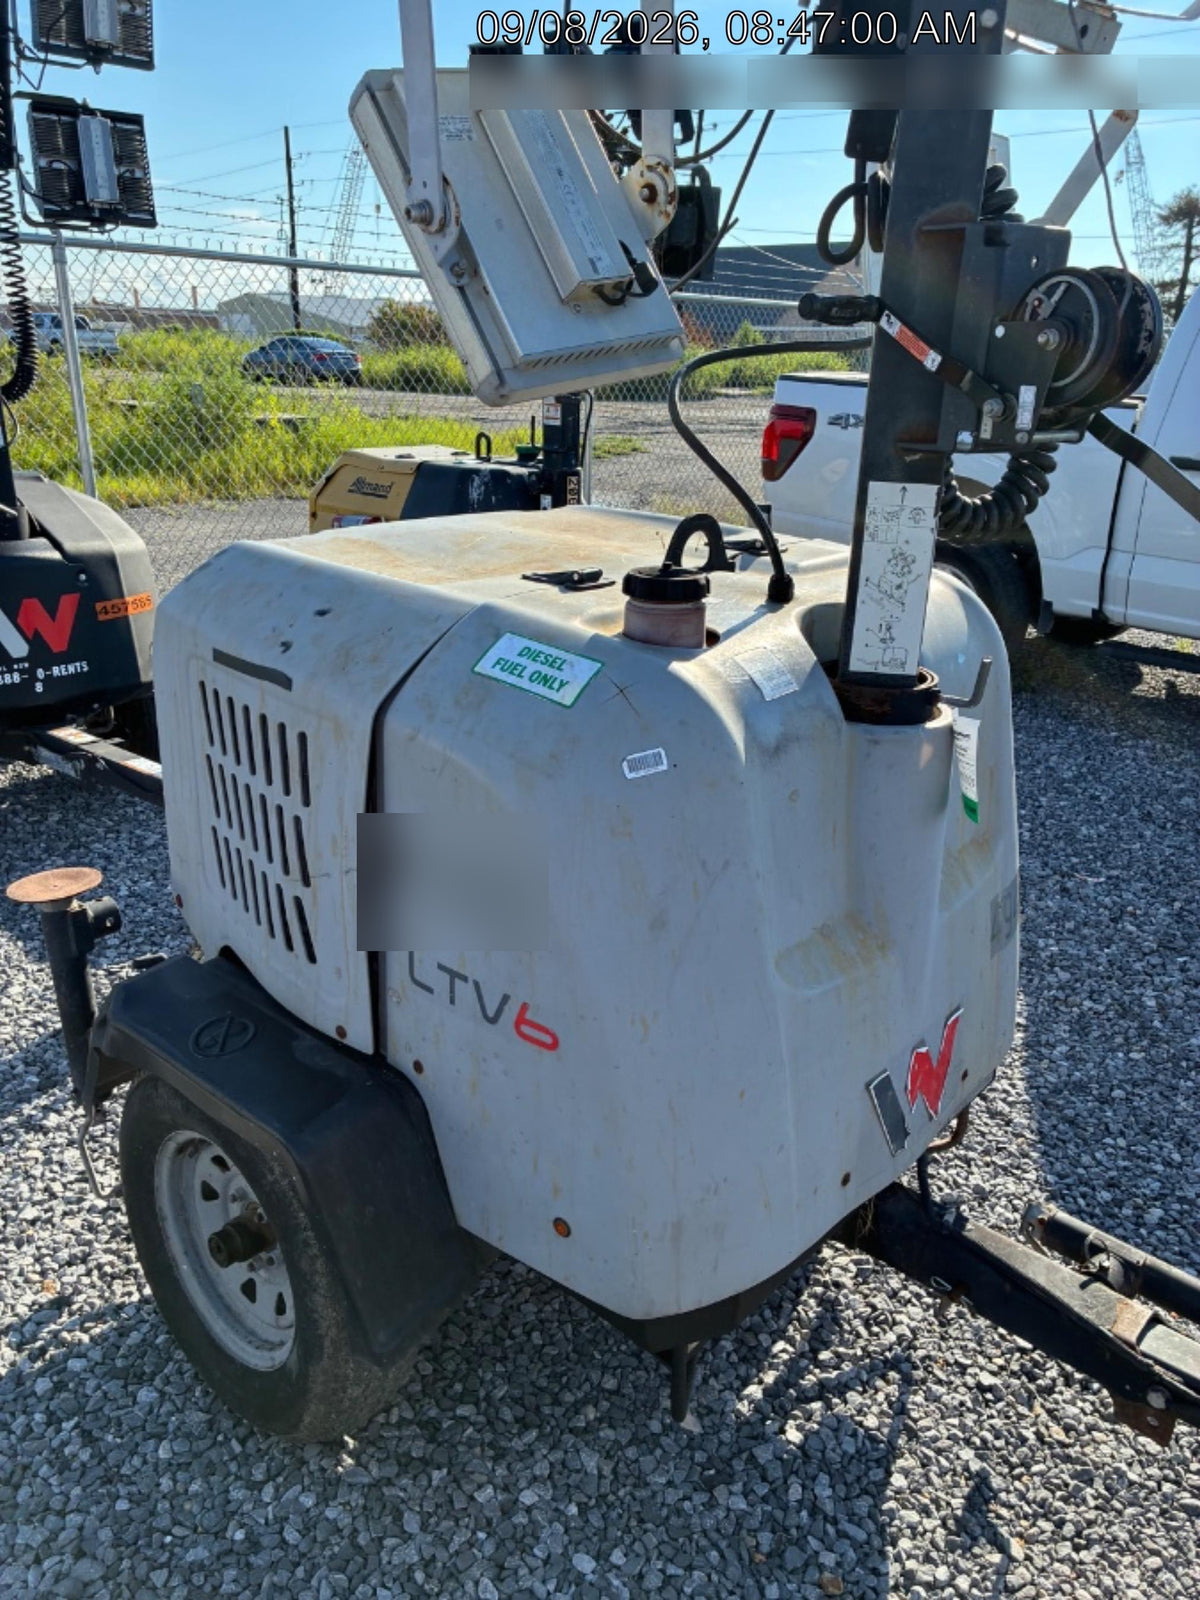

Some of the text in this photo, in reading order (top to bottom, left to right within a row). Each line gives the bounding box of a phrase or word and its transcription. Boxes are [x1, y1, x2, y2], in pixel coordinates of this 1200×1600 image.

[517, 646, 567, 671] DIESEL
[491, 657, 570, 693] FUEL ONLY
